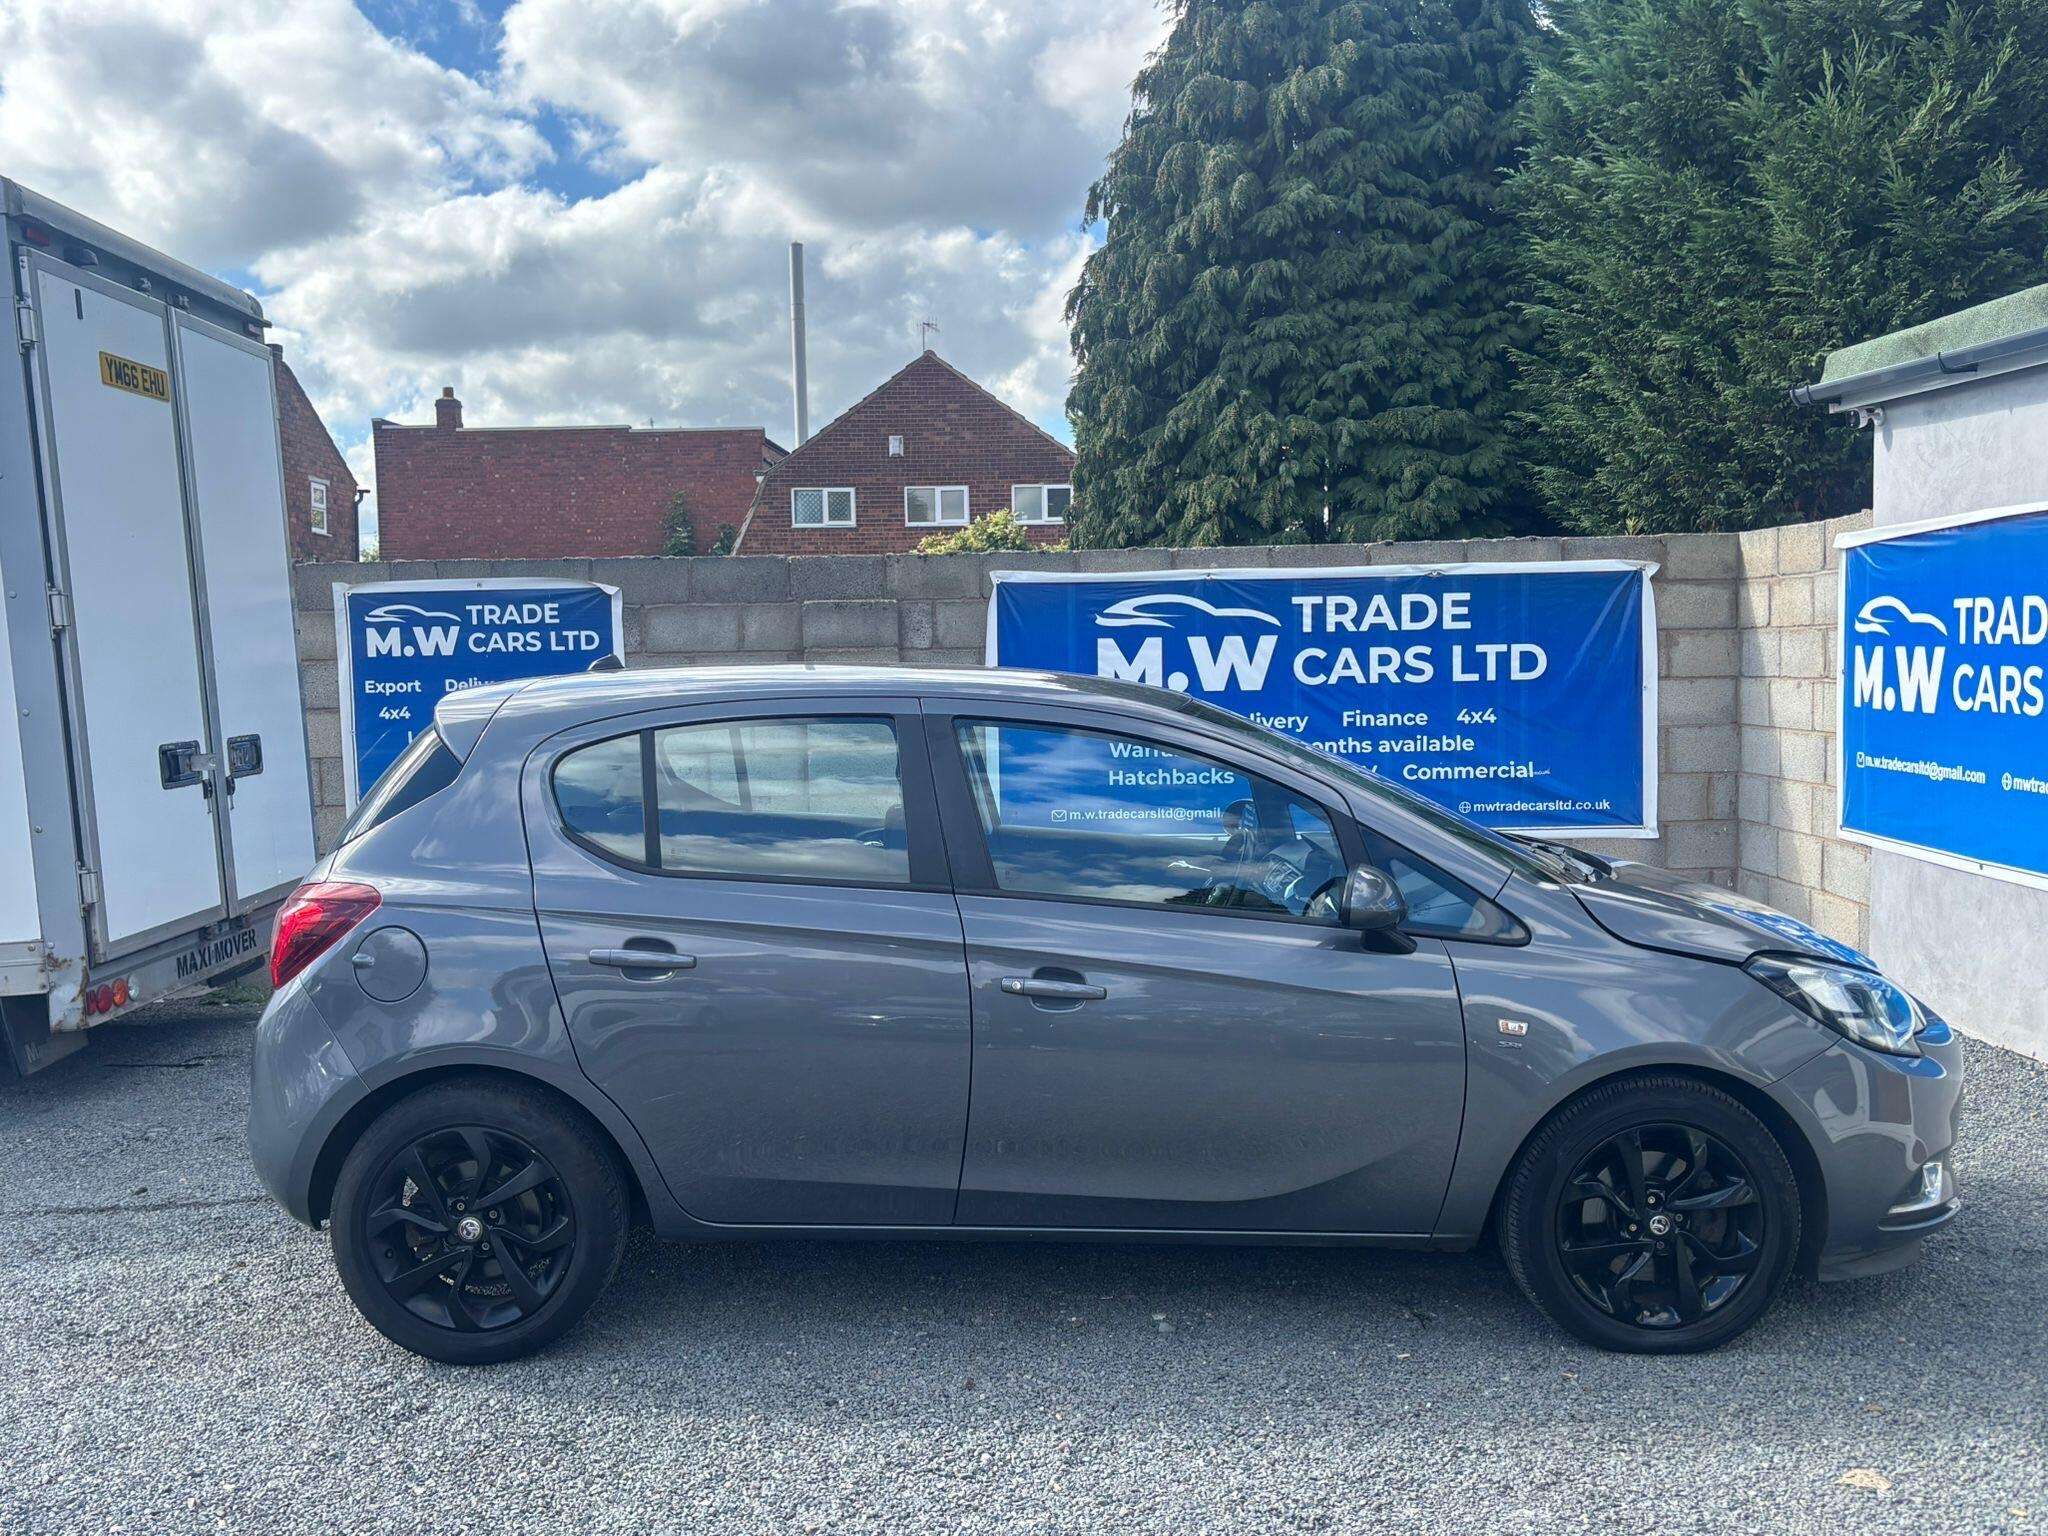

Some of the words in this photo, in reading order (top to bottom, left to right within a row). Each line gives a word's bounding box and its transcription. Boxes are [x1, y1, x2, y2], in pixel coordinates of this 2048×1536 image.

[465, 603, 560, 626] TRADE
[1291, 592, 1472, 633] TRADE
[1953, 595, 2048, 645] TRAD
[365, 626, 460, 658] M.W
[468, 631, 542, 653] CARS
[550, 630, 600, 651] LTD
[1097, 635, 1279, 693] M.W
[1293, 645, 1434, 686] CARS
[1452, 643, 1548, 682] LTD
[364, 679, 422, 697] Export
[1853, 645, 1946, 715] M.W
[1952, 663, 2045, 717] CARS
[378, 705, 411, 720] 4x4
[1342, 709, 1428, 728] Finance
[1456, 707, 1498, 724] 4x4
[1378, 734, 1475, 753] available
[1108, 767, 1235, 786] Hatchbacks
[1402, 760, 1534, 781] Commercial
[1473, 799, 1611, 813] mwtradecarsltd.co.uk
